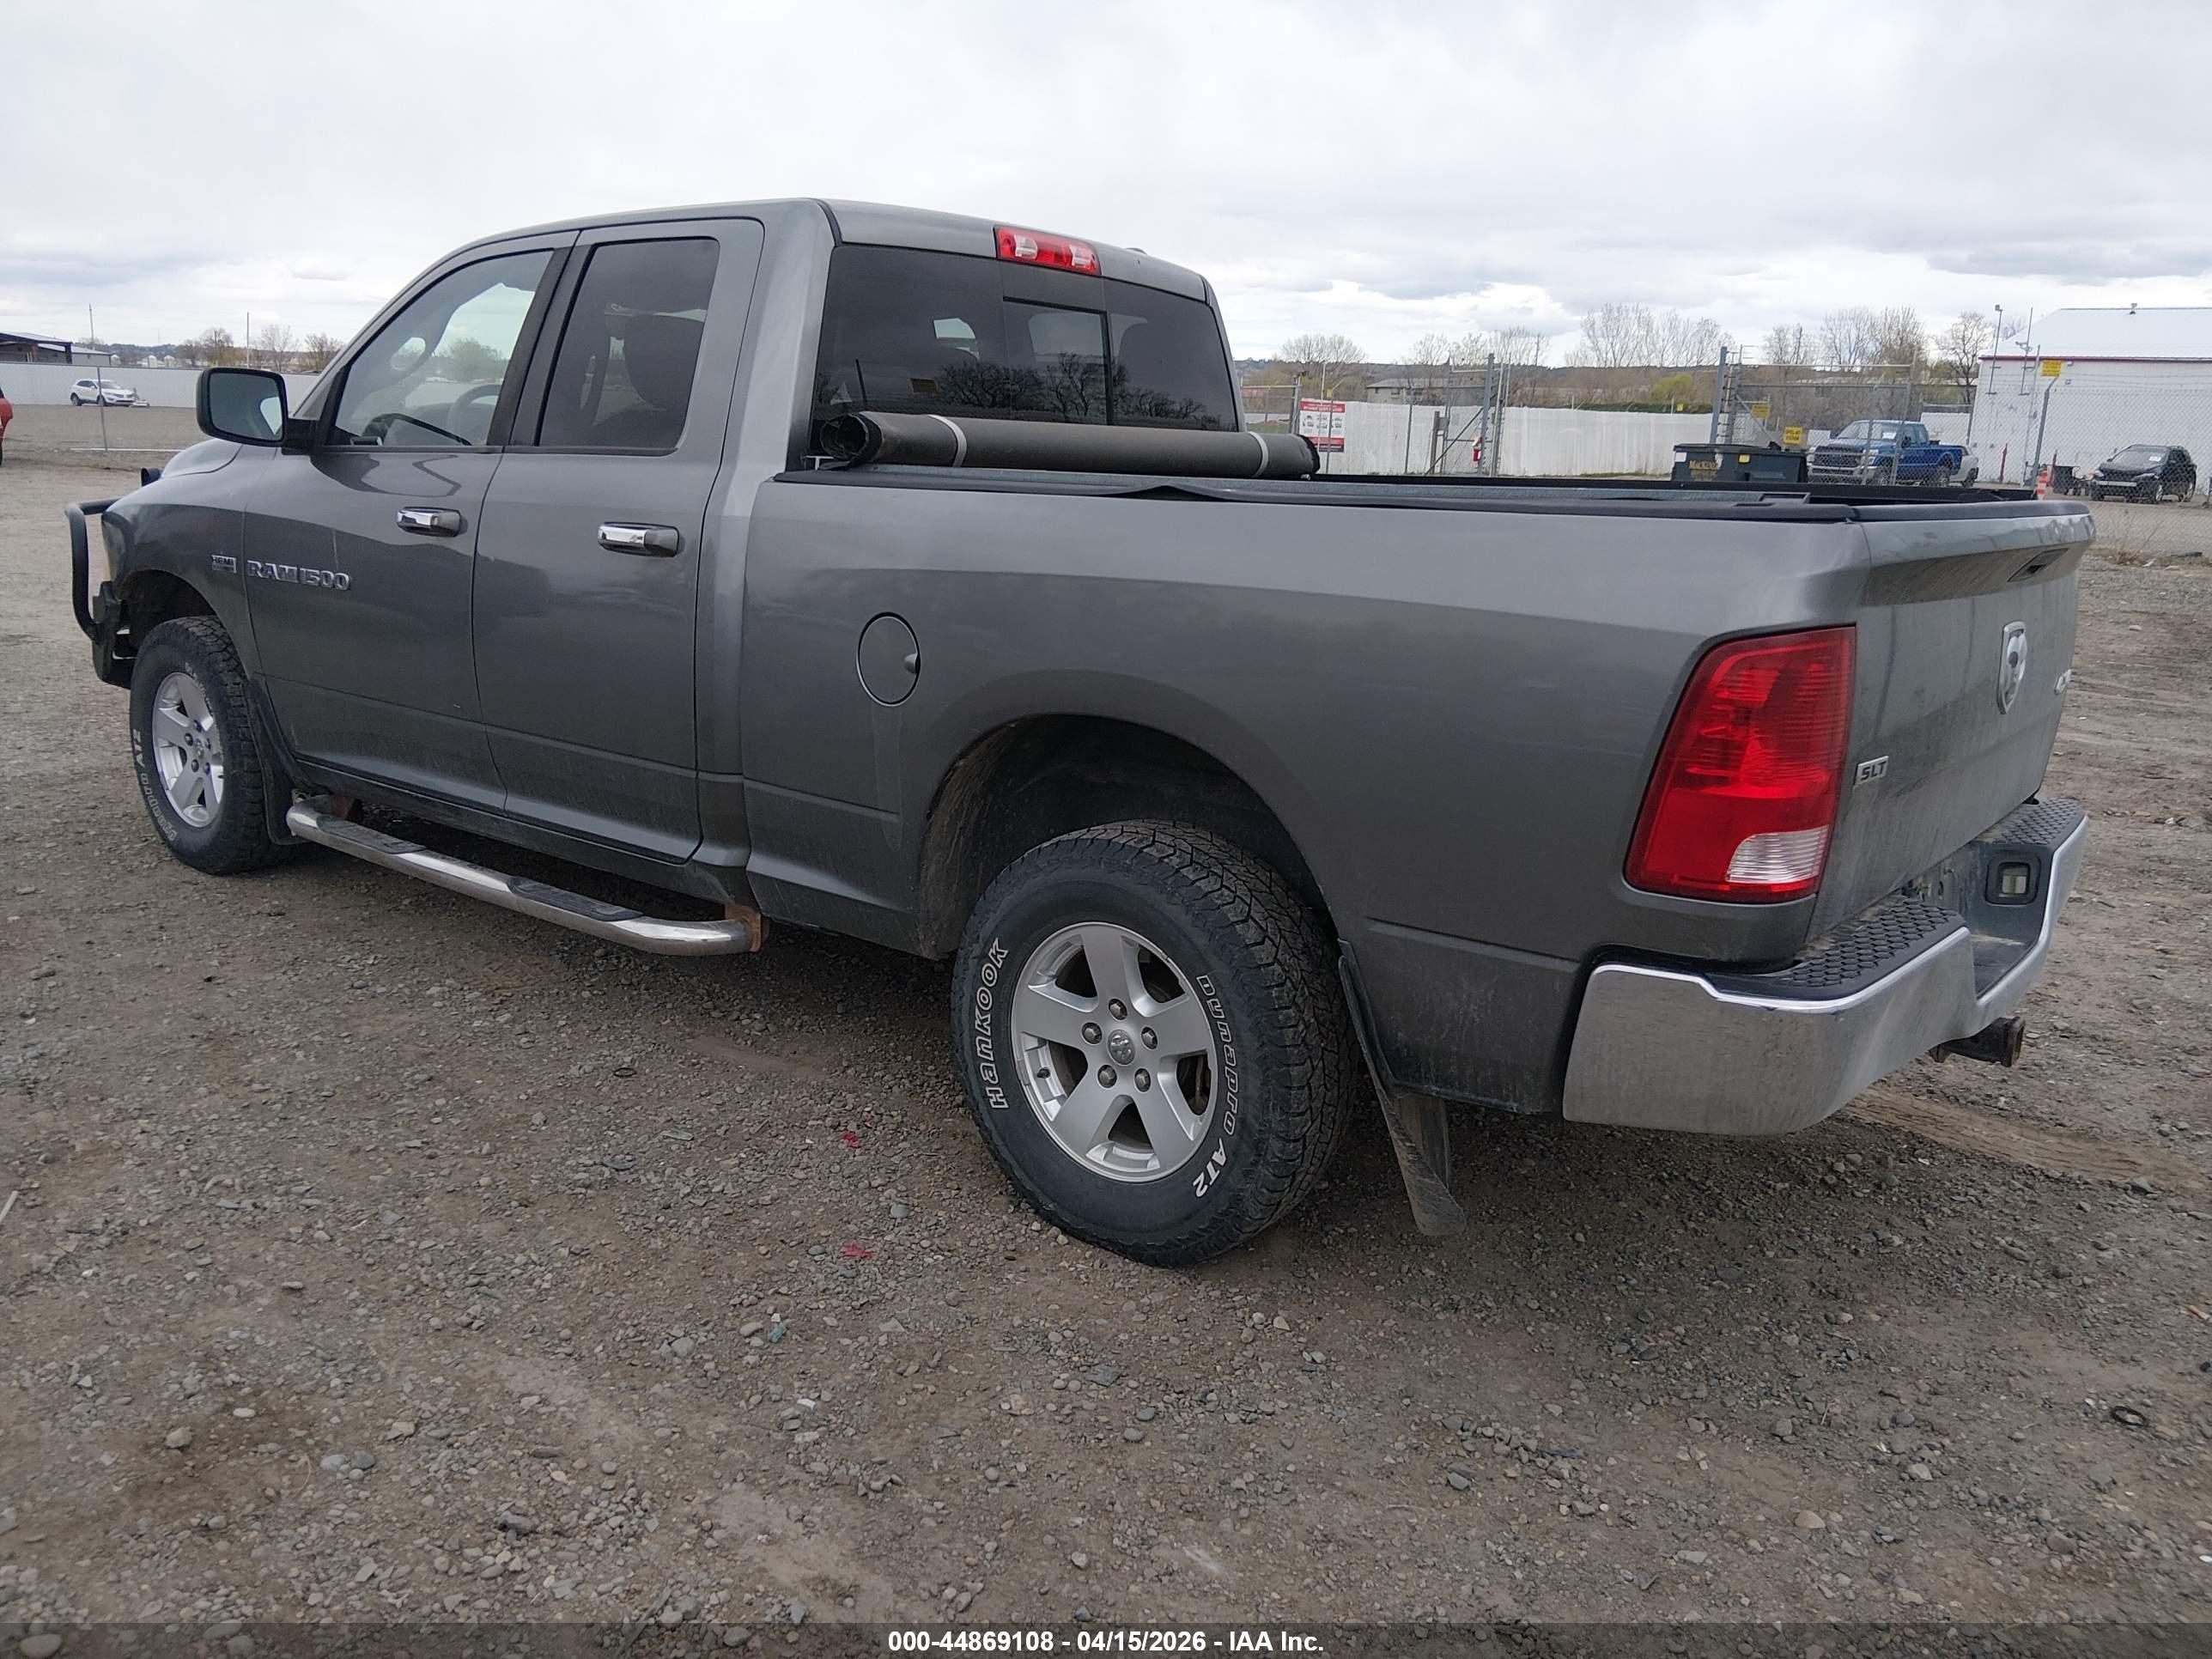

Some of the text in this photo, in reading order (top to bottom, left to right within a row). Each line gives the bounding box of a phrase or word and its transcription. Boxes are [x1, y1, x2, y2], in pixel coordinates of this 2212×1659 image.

[246, 559, 351, 591] RAM 1500
[1860, 761, 1887, 781] SLT
[1191, 1138, 1228, 1198] AT2
